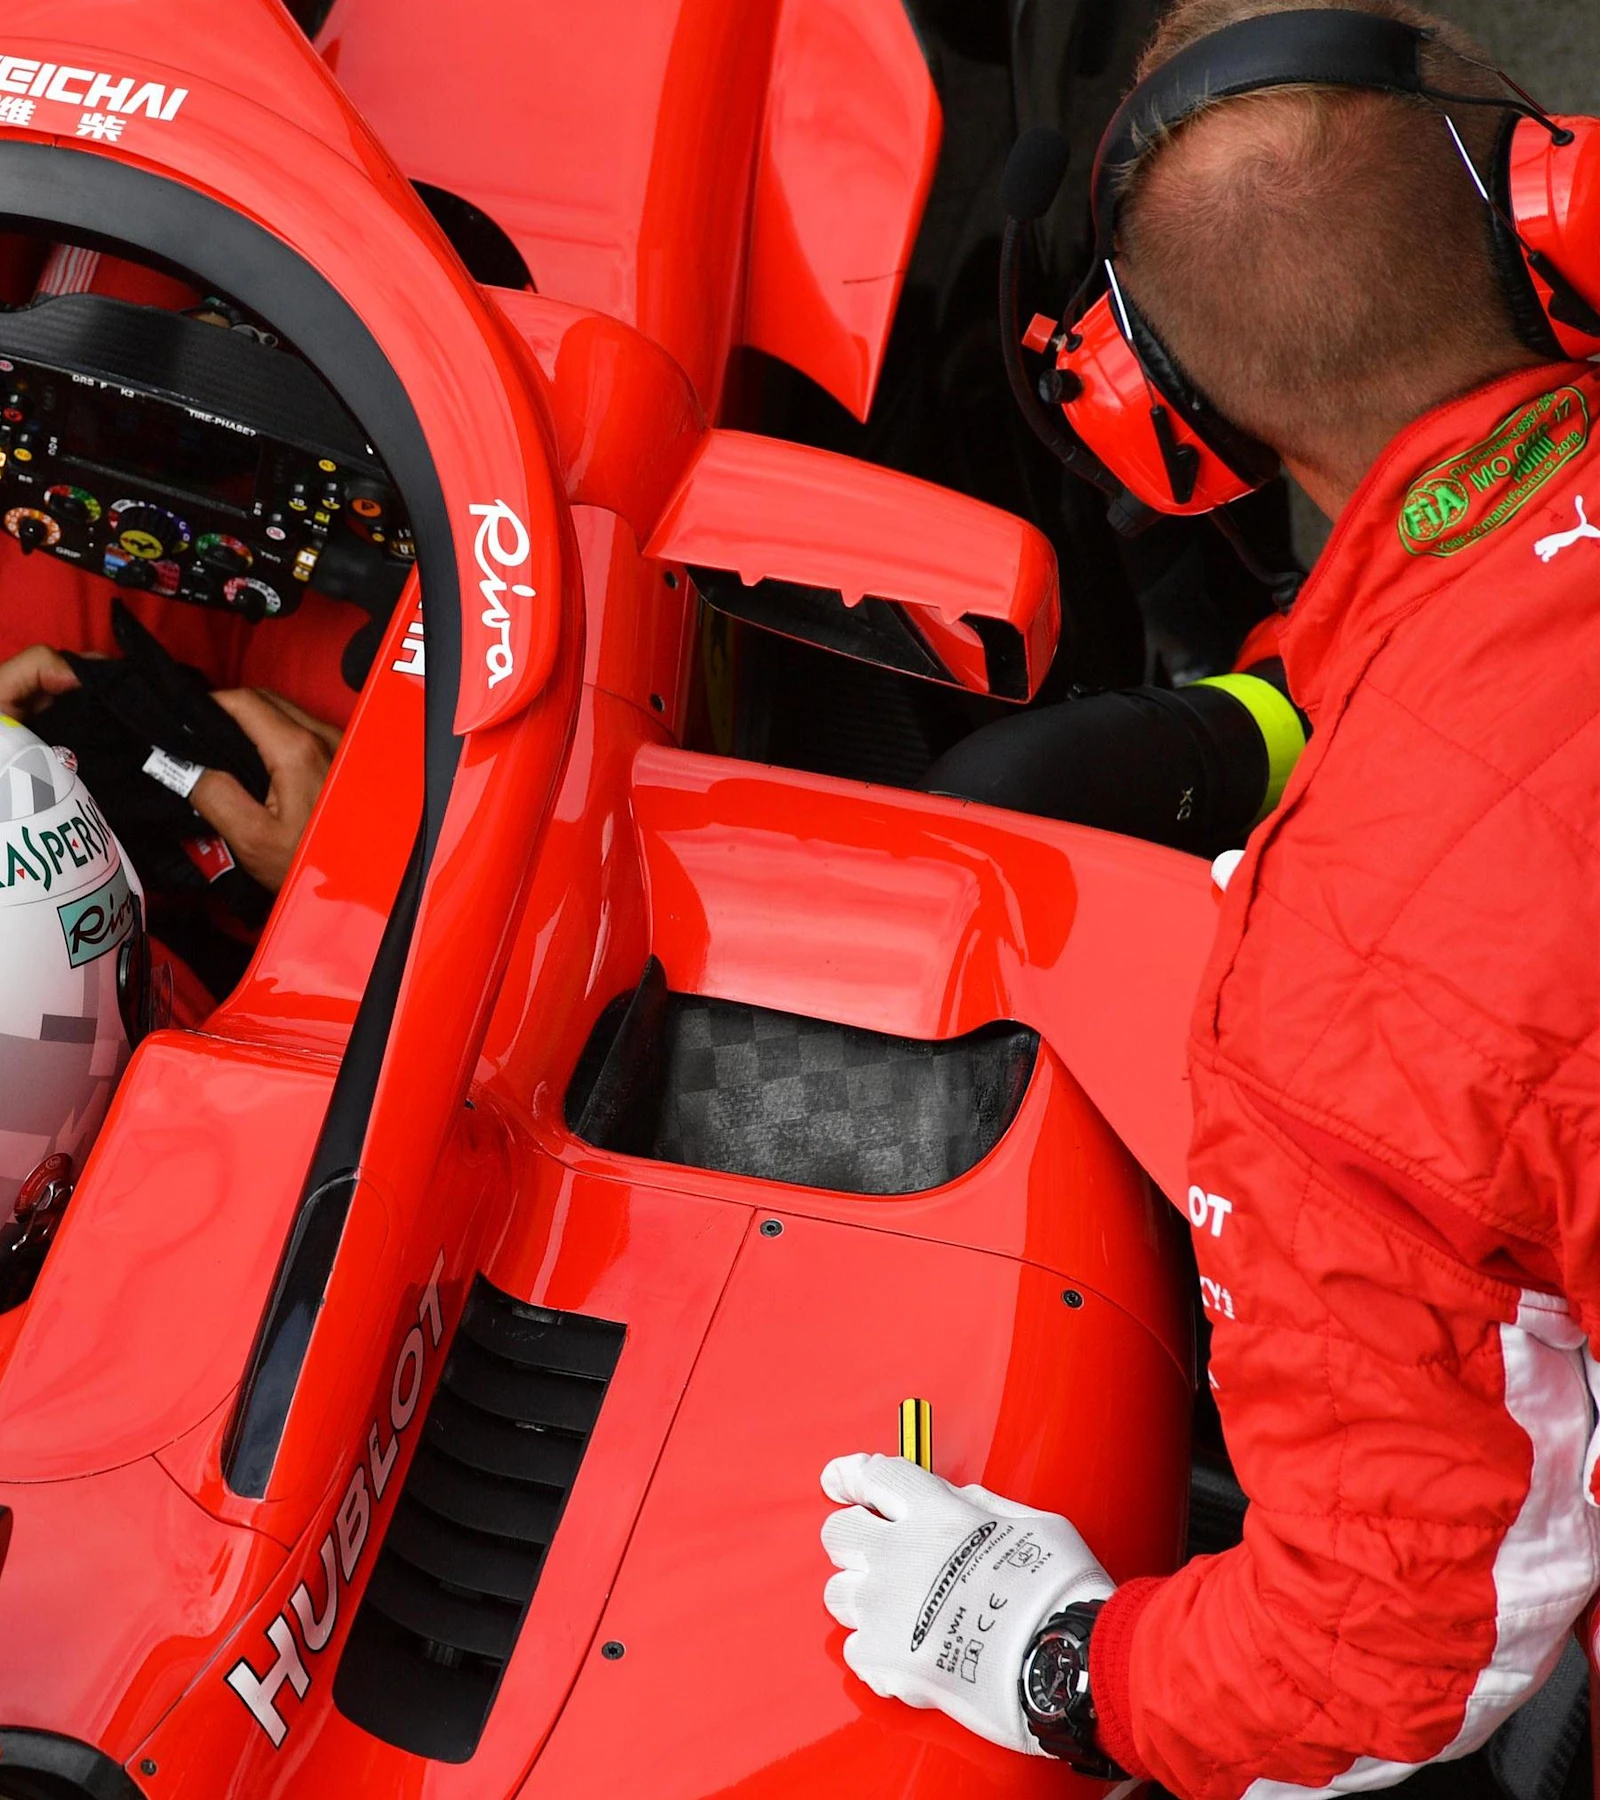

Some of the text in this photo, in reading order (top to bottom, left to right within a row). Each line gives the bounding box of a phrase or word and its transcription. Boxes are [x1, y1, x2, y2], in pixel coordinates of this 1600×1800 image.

[72, 373, 95, 387] DRS
[1554, 431, 1582, 456] 2018
[56, 546, 81, 558] GRIP
[469, 499, 537, 690] Riva
[225, 1249, 445, 1750] HUBLOT
[912, 1525, 992, 1645] Summitech
[948, 1606, 967, 1635] WH
